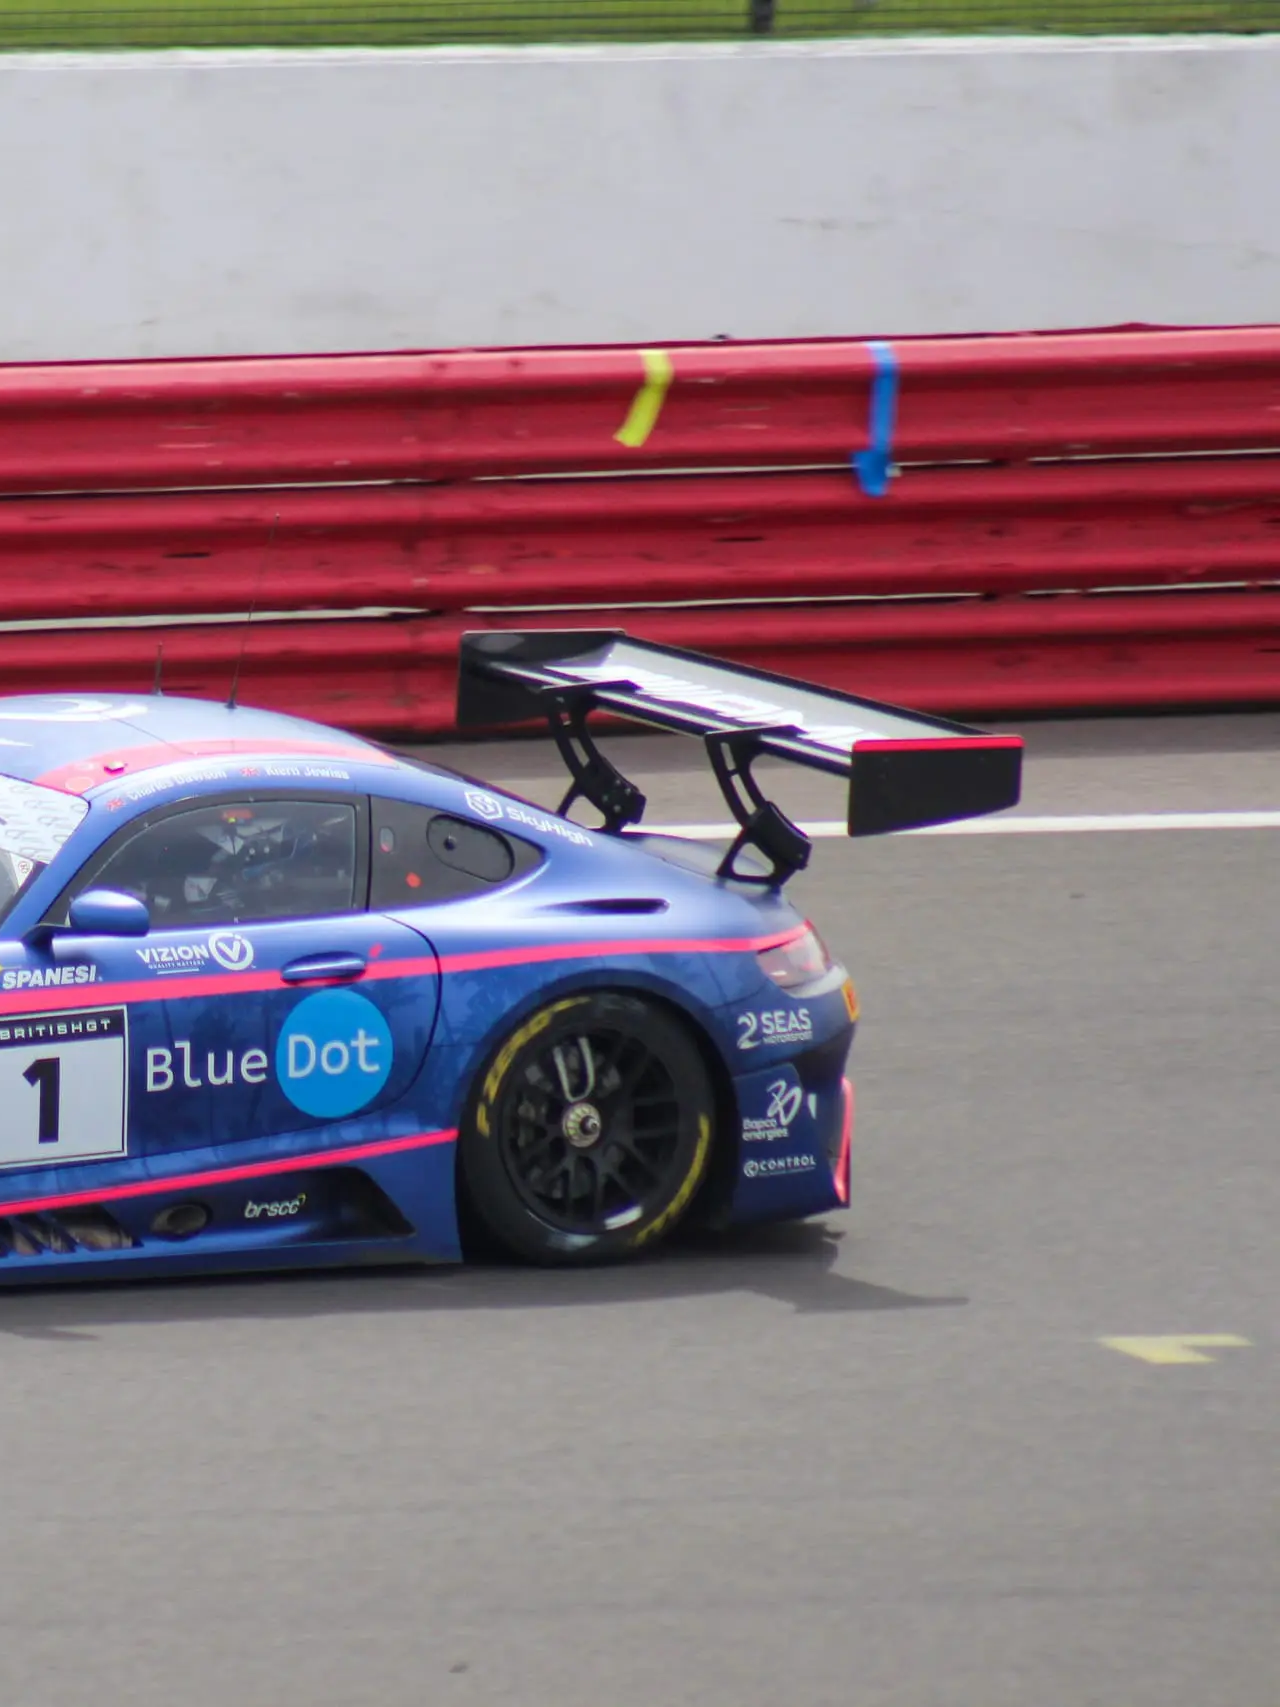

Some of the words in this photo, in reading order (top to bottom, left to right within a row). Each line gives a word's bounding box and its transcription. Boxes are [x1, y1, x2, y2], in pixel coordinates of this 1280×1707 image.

[506, 806, 593, 847] SkyHigh
[135, 944, 210, 963] VIZION
[2, 965, 97, 990] SPANESI
[736, 1011, 761, 1049] 2
[761, 1008, 812, 1034] SEAS
[146, 1040, 269, 1093] Blue
[287, 1029, 380, 1079] Dot
[22, 1056, 61, 1145] 1
[742, 1127, 789, 1142] energies
[759, 1154, 817, 1171] CONTROL
